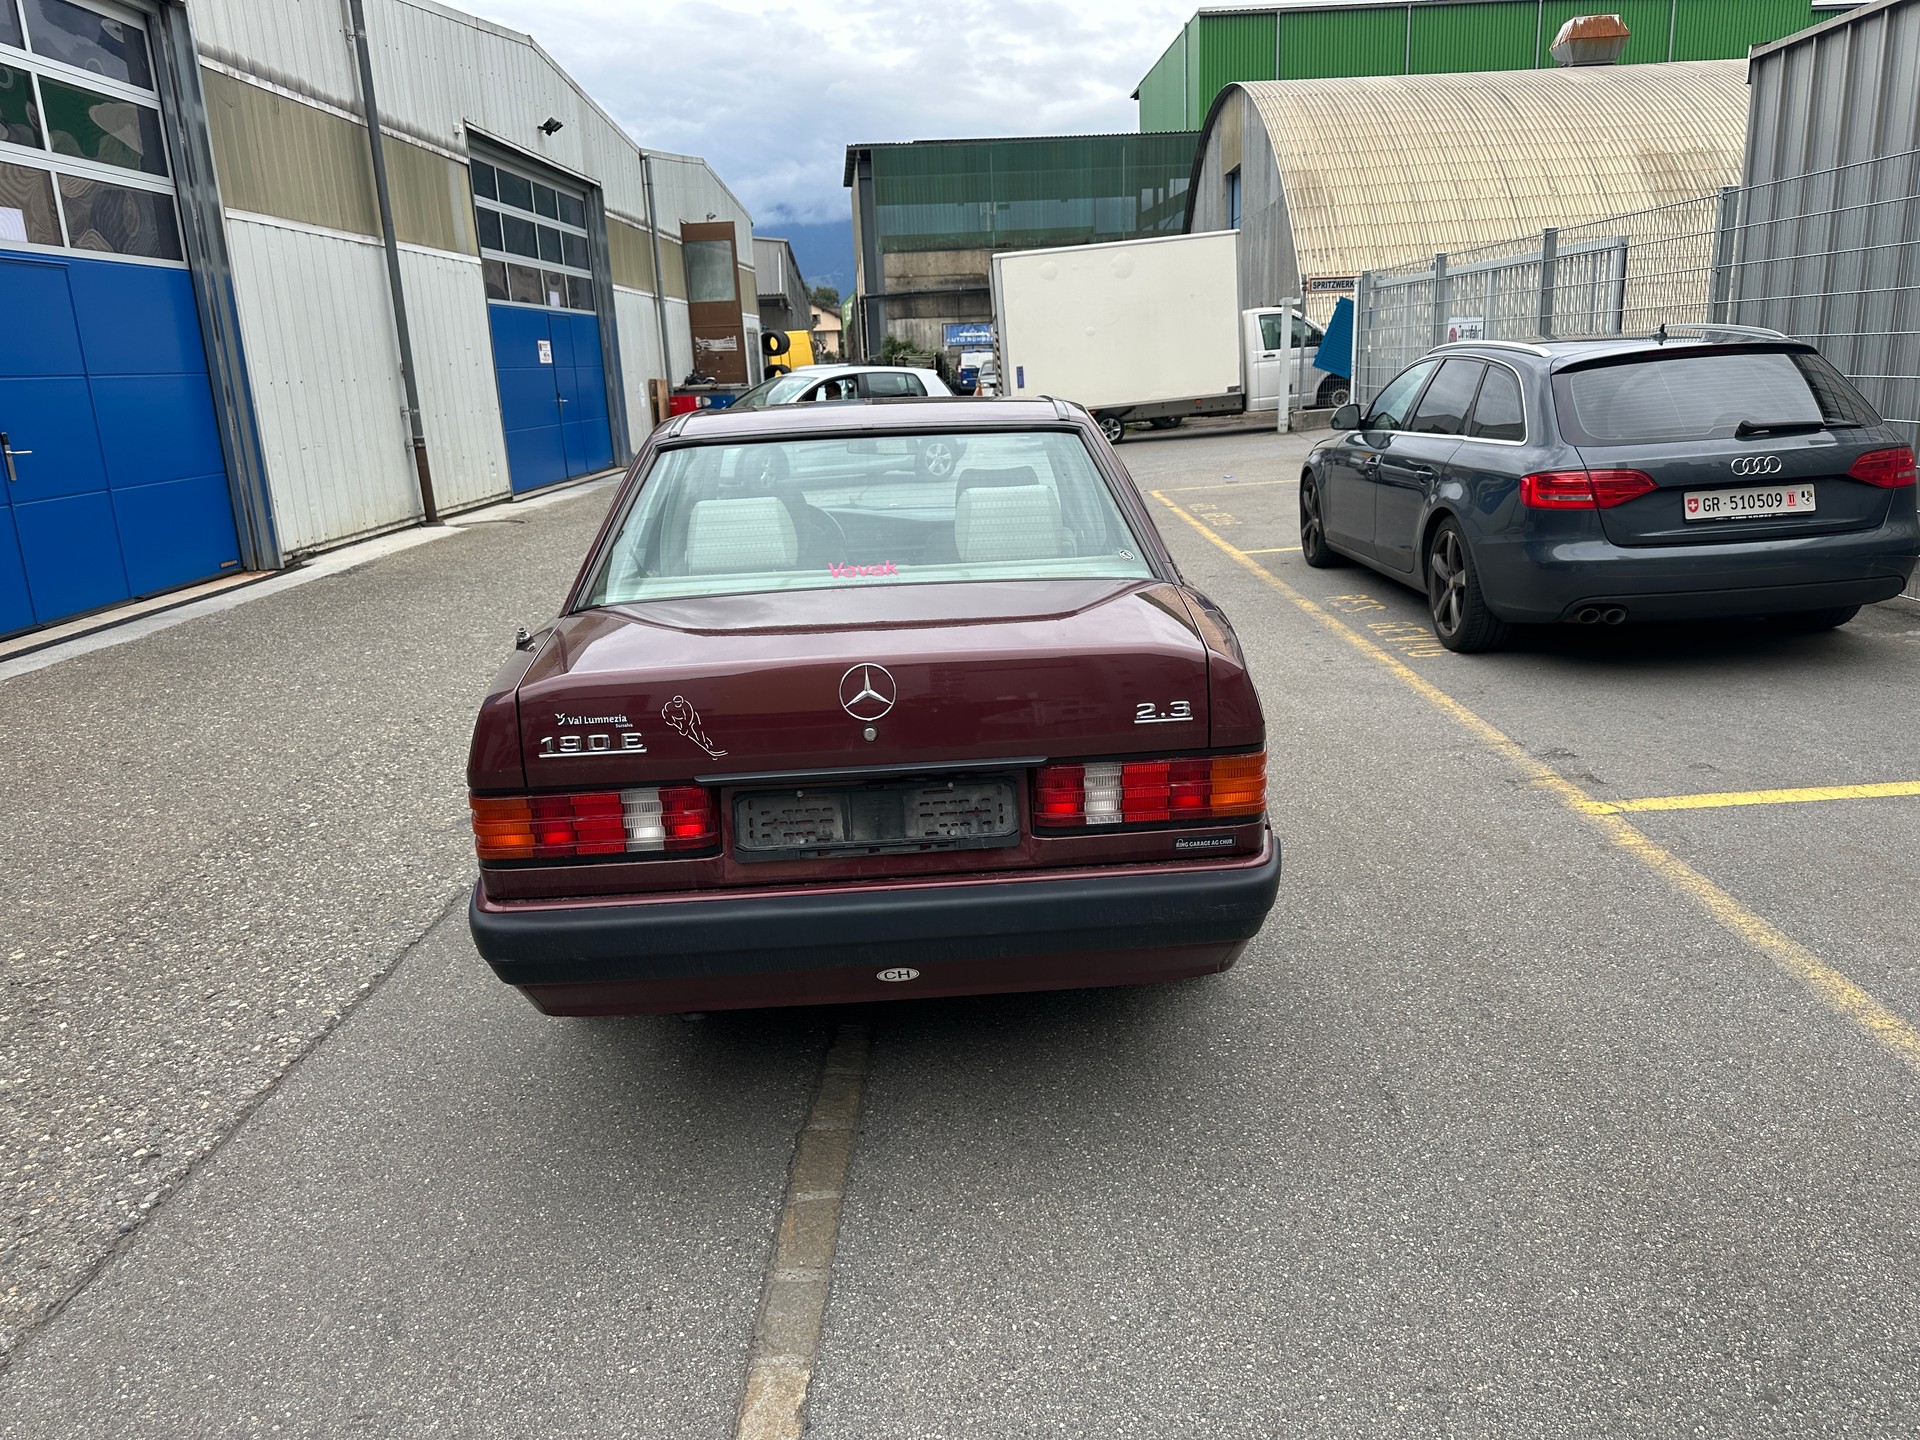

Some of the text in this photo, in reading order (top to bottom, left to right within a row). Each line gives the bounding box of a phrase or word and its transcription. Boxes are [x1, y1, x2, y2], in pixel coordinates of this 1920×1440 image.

[828, 559, 899, 579] Vavak
[567, 713, 628, 725] Val Lumnezia
[1136, 700, 1191, 720] 2.3
[540, 732, 644, 753] 190 E
[884, 969, 911, 980] CH
